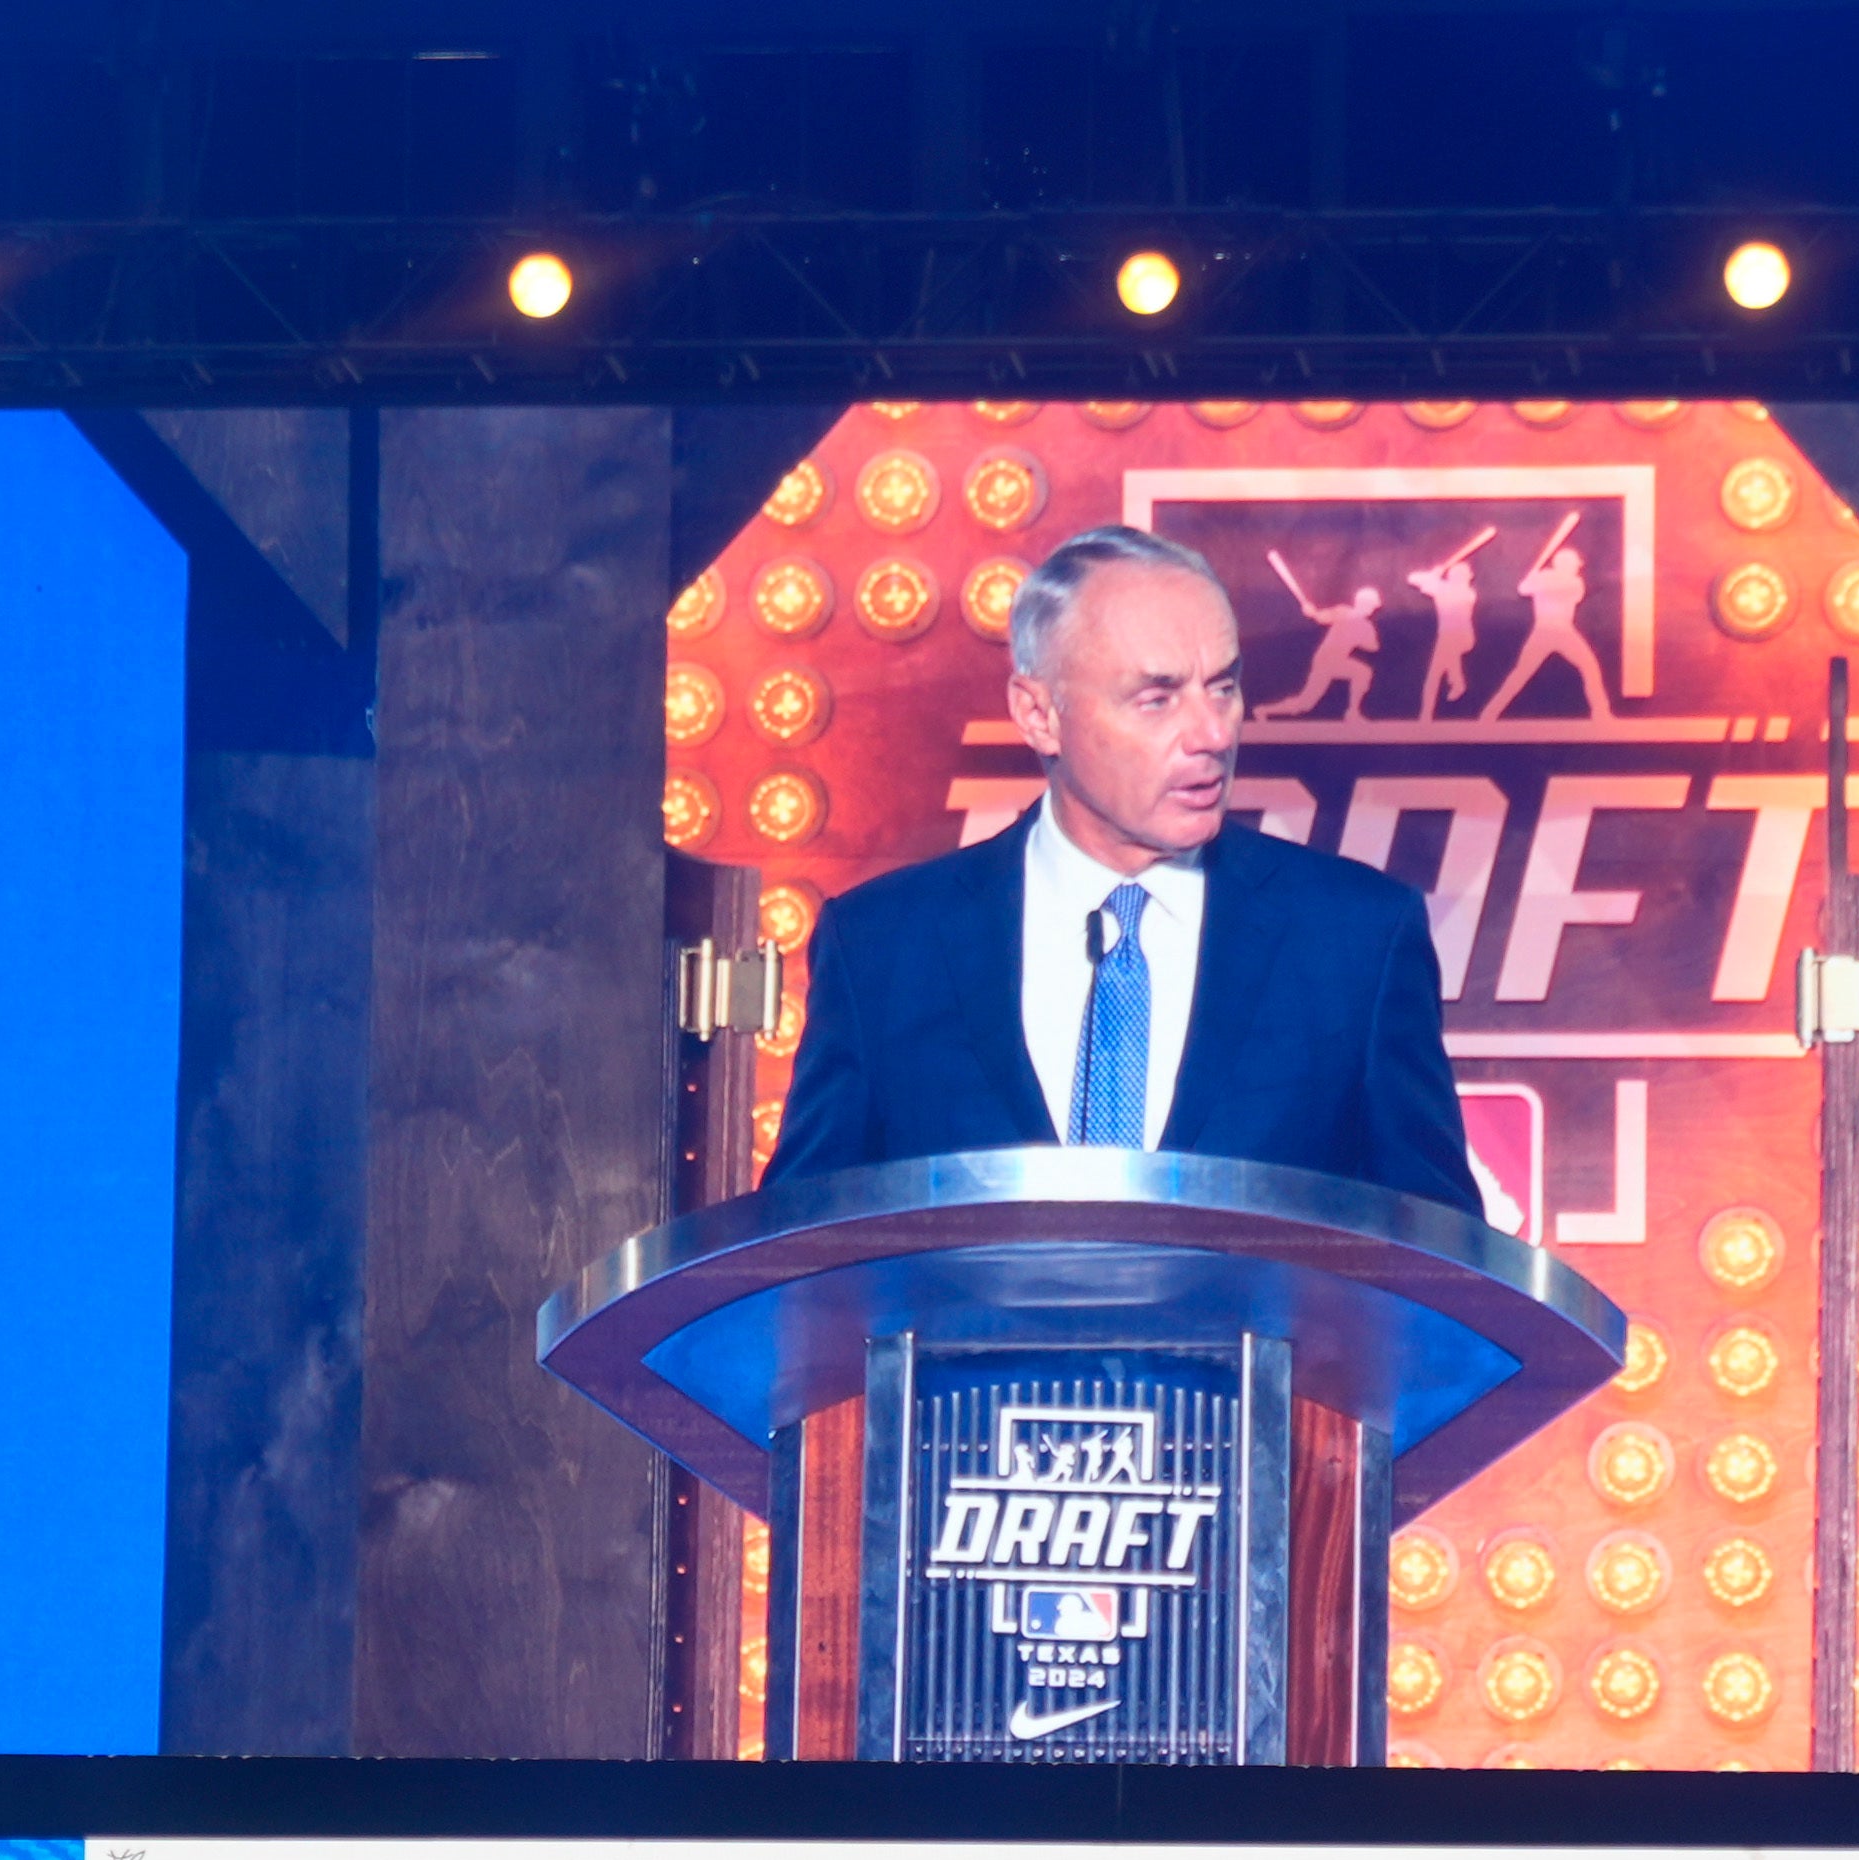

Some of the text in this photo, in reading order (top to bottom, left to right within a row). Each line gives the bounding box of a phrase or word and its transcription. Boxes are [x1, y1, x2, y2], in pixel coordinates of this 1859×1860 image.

[930, 1495, 1218, 1569] DRAFT
[1018, 1645, 1120, 1666] TEXAS
[1028, 1668, 1106, 1689] 2024
